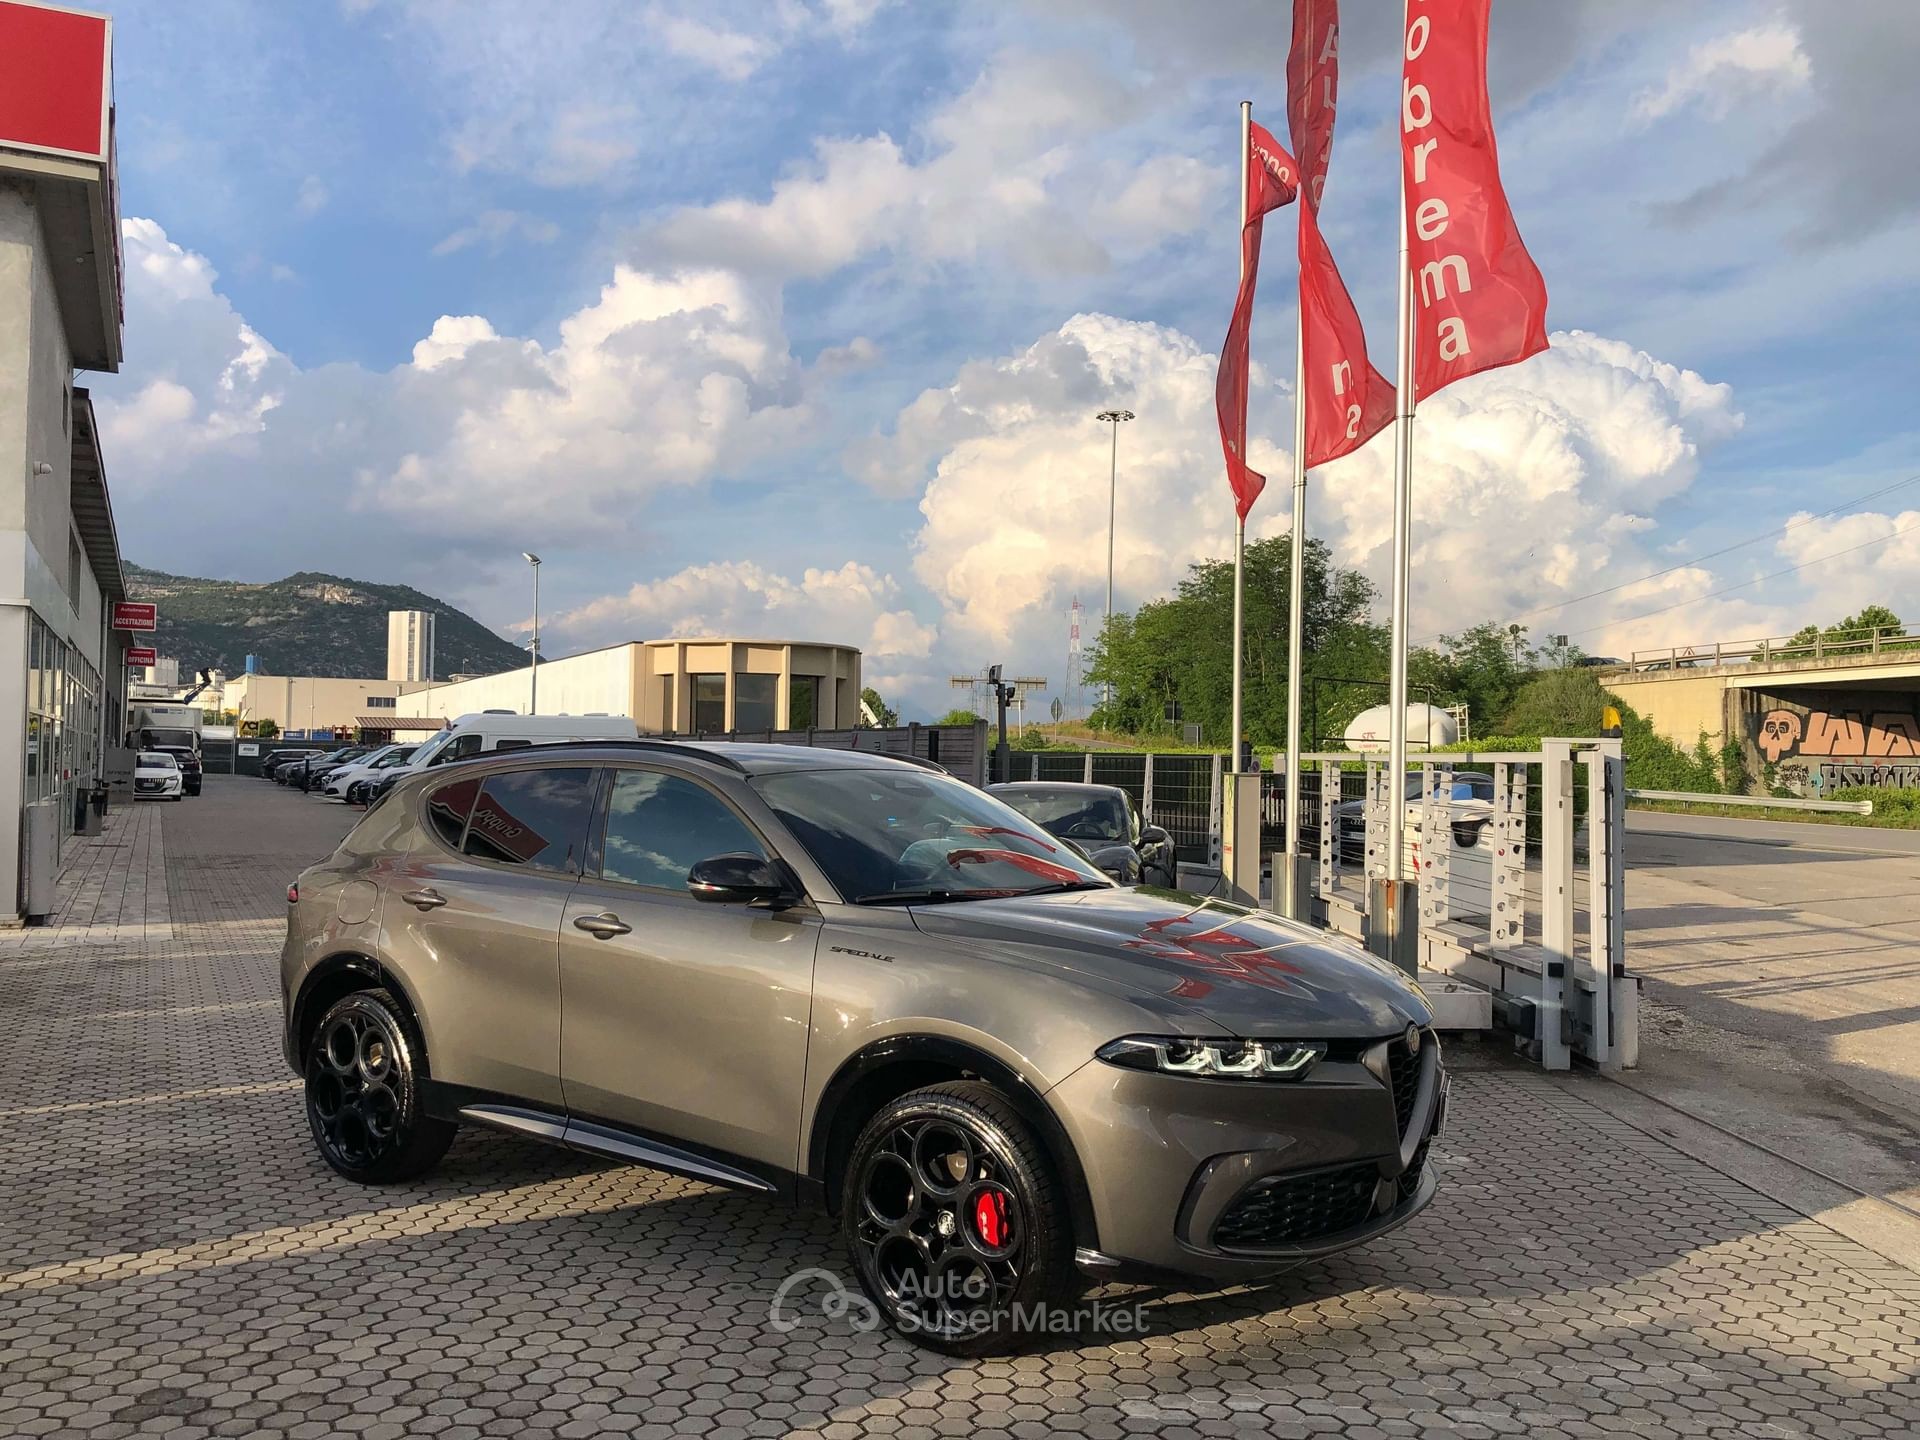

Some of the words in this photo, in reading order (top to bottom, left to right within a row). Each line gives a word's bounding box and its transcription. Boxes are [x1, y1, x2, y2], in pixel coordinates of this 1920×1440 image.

[1403, 0, 1471, 362] obrema
[115, 617, 154, 627] ACCETTAZIONE
[127, 656, 154, 664] OFFICINA
